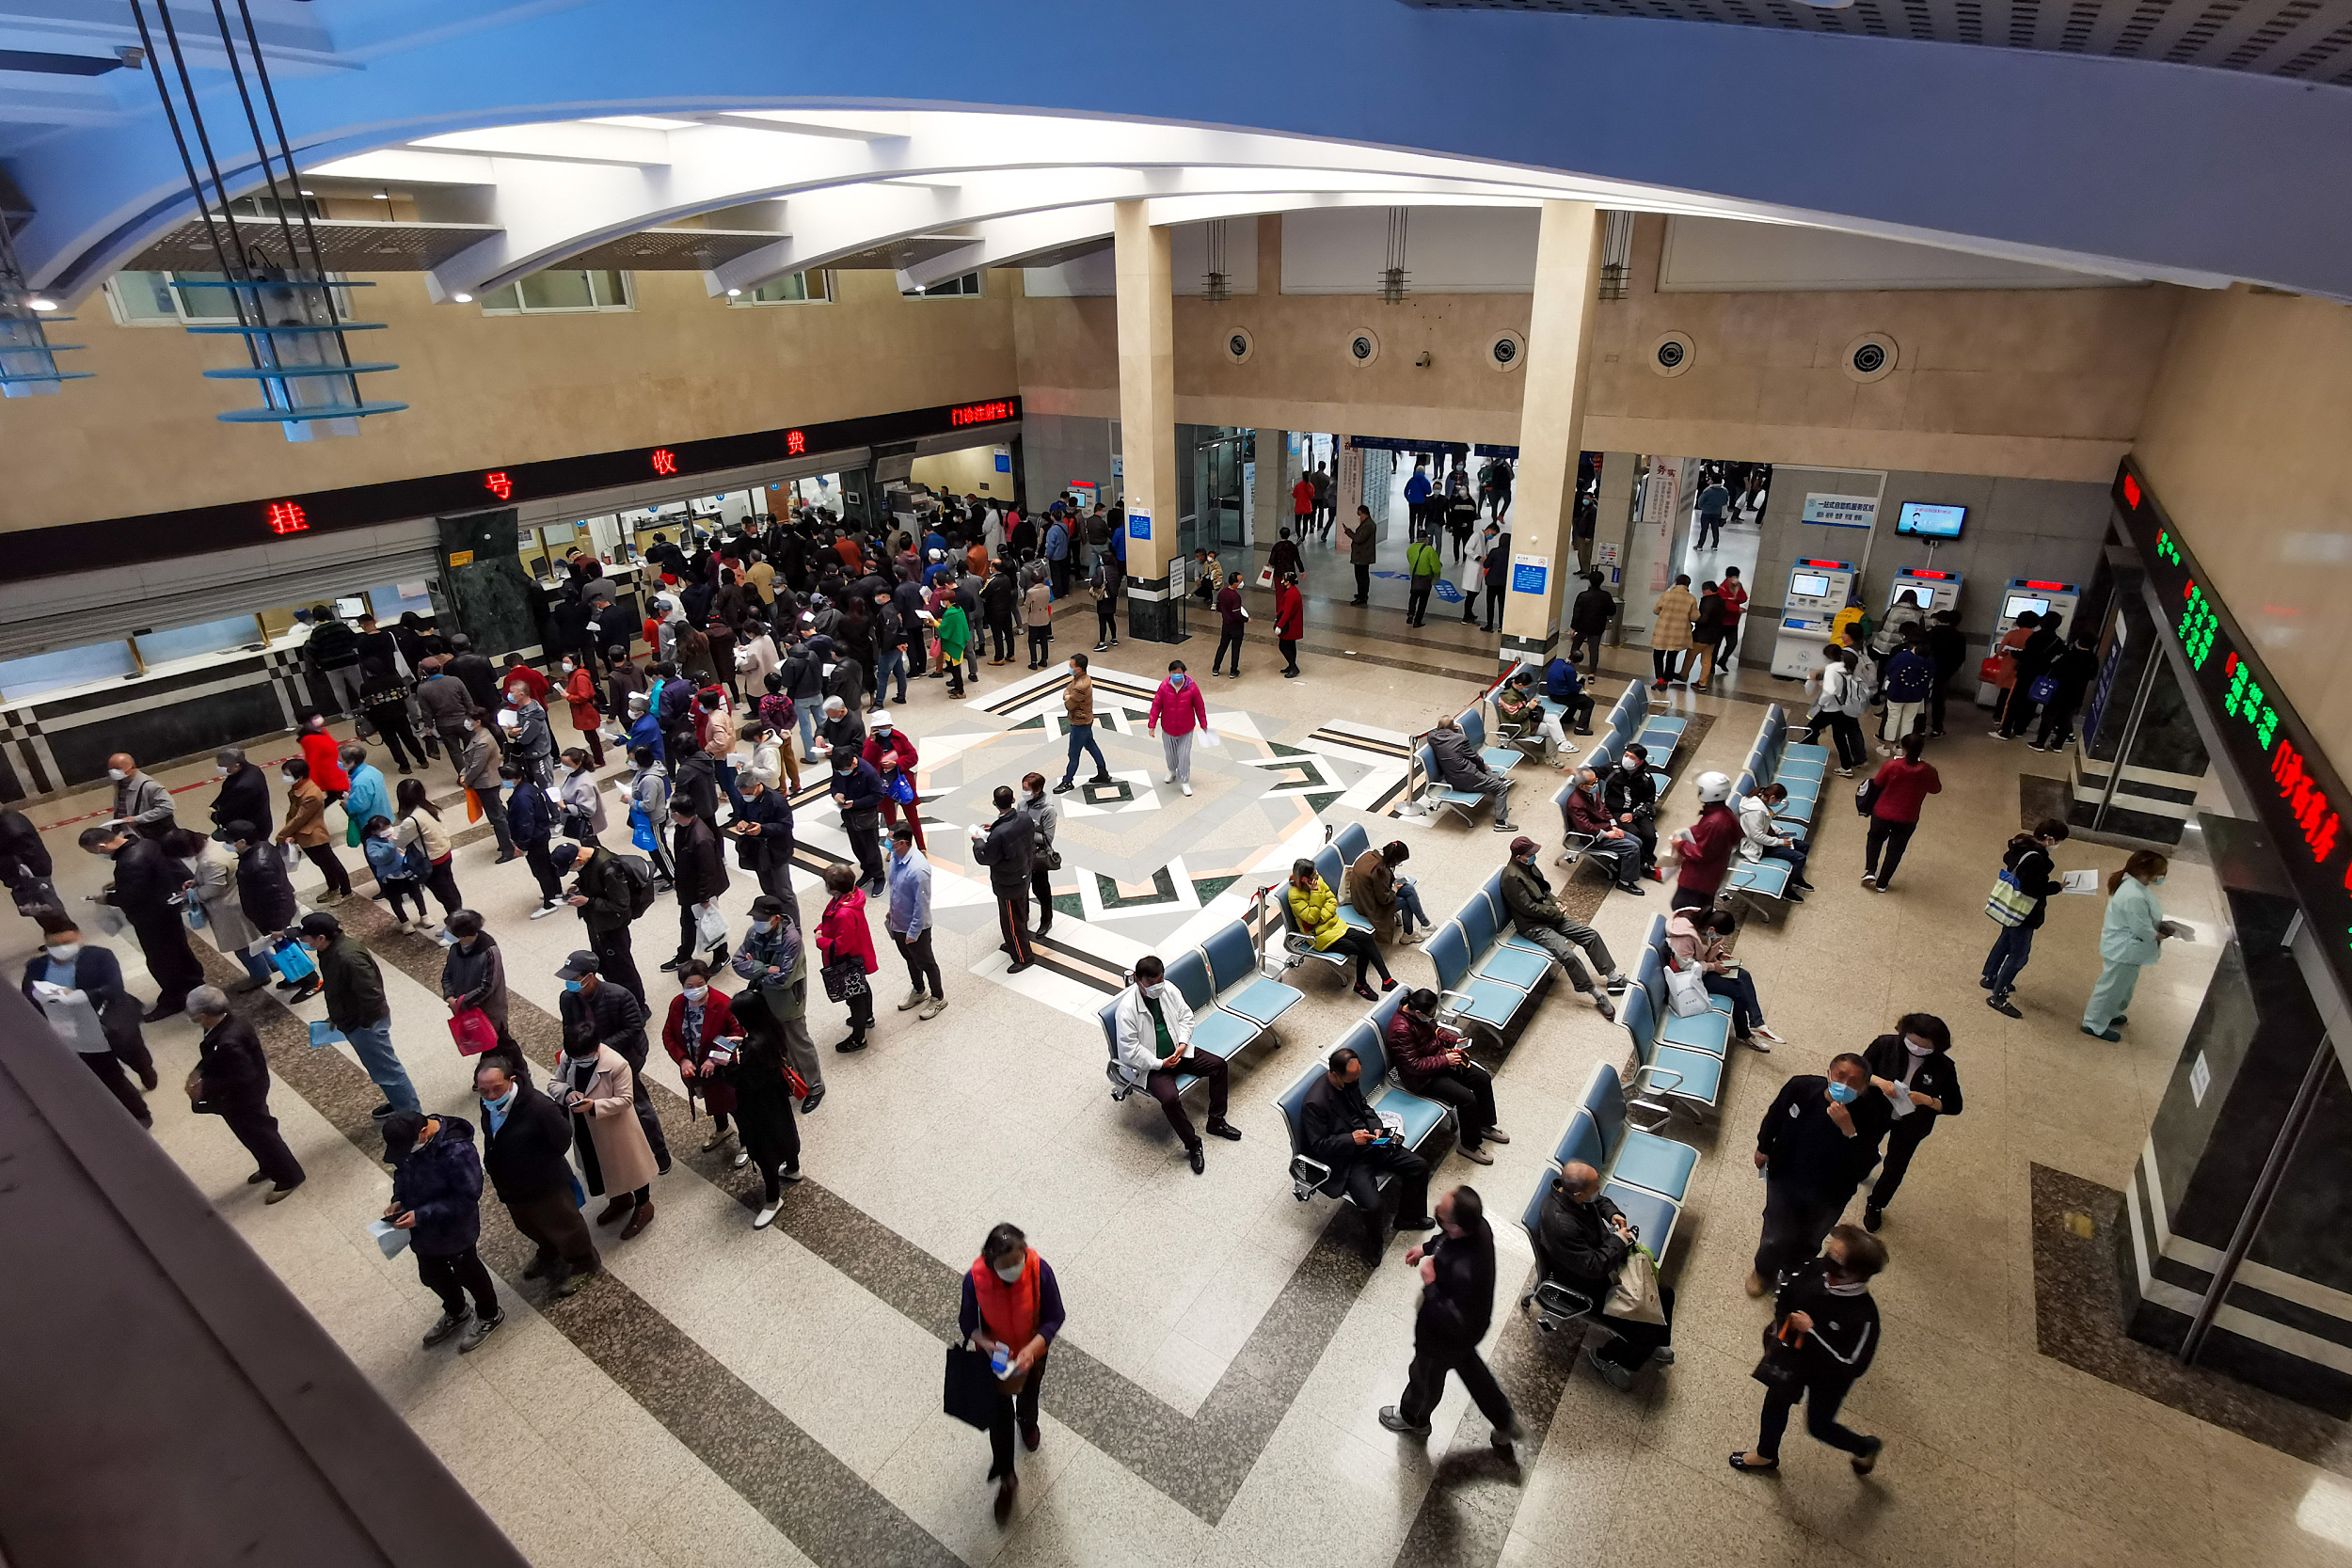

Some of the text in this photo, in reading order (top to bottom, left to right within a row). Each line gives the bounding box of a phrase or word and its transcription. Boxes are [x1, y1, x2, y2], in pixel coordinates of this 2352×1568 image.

[268, 429, 806, 535] 挂 号 收 费
